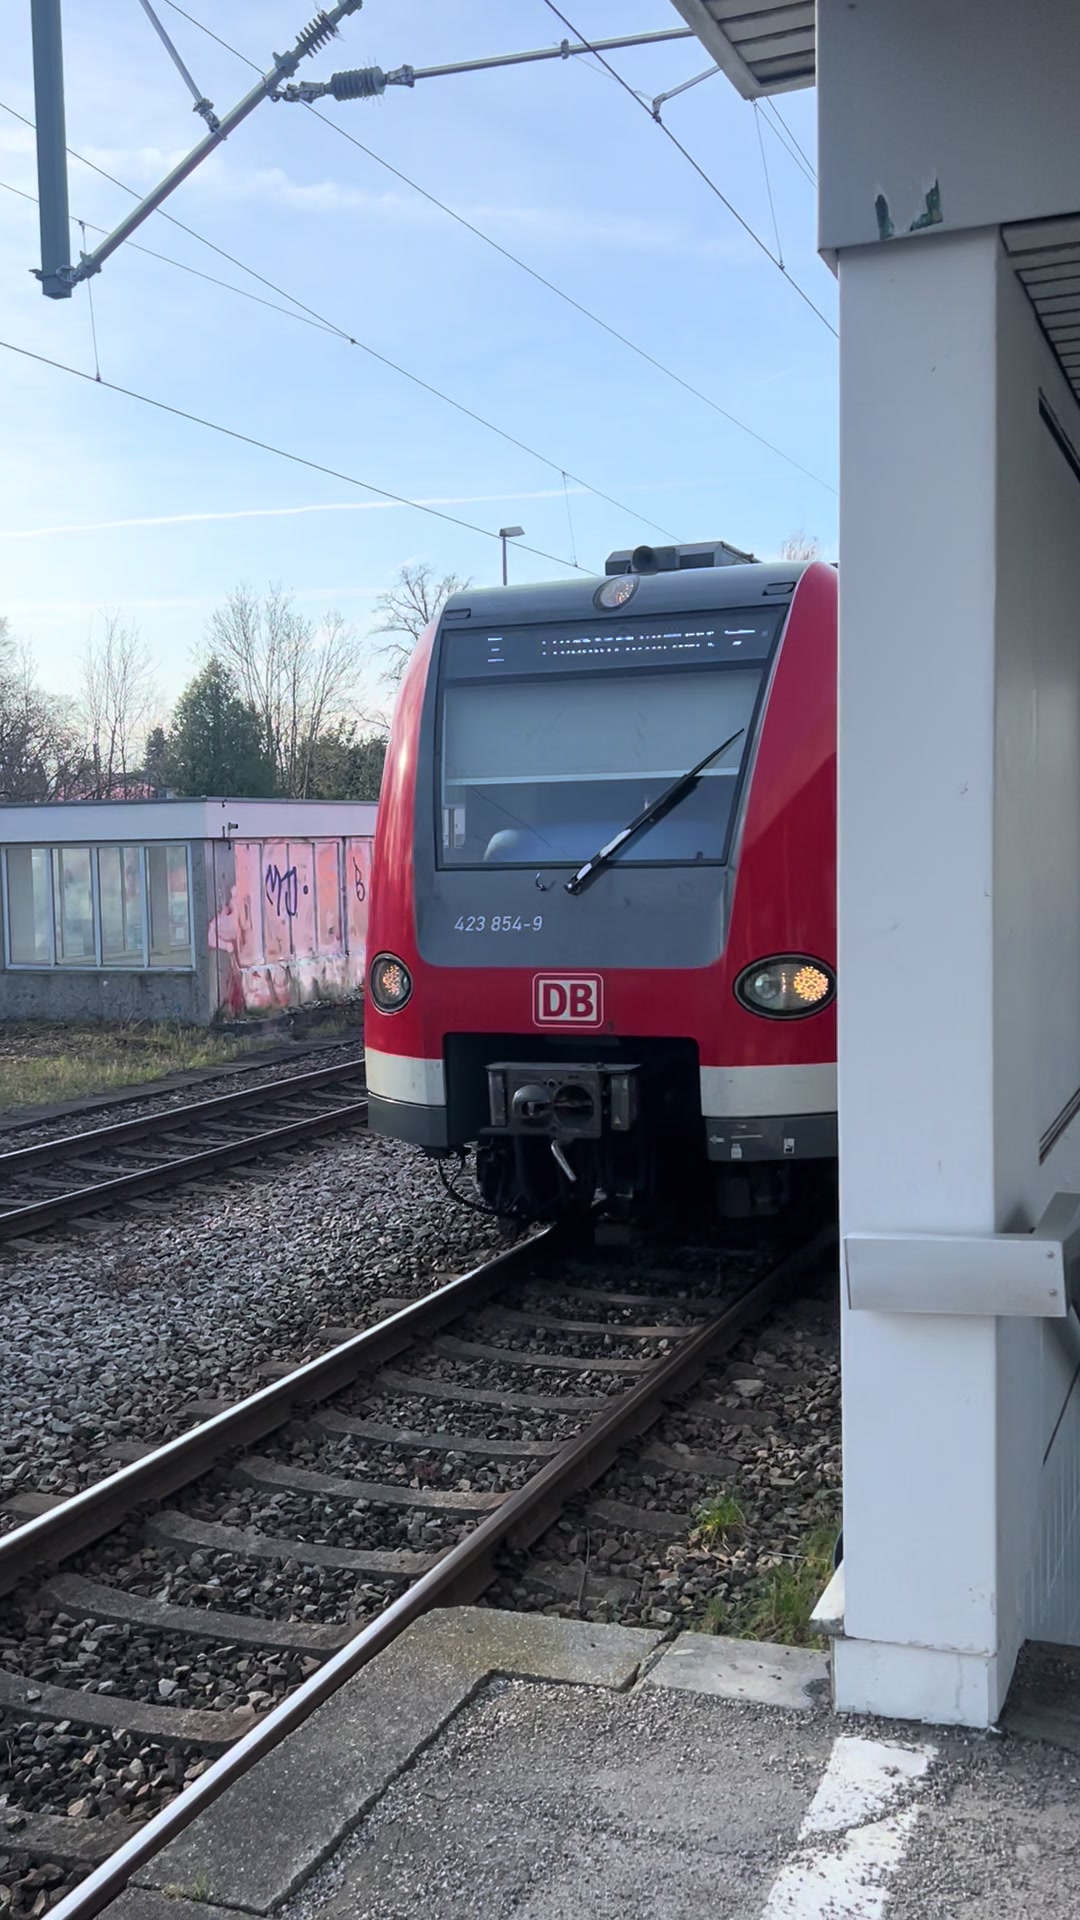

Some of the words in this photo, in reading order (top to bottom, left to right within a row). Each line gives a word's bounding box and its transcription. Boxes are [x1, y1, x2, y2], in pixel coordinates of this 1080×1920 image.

[454, 915, 486, 931] 423
[490, 915, 543, 931] 854-9
[541, 982, 595, 1019] DB
